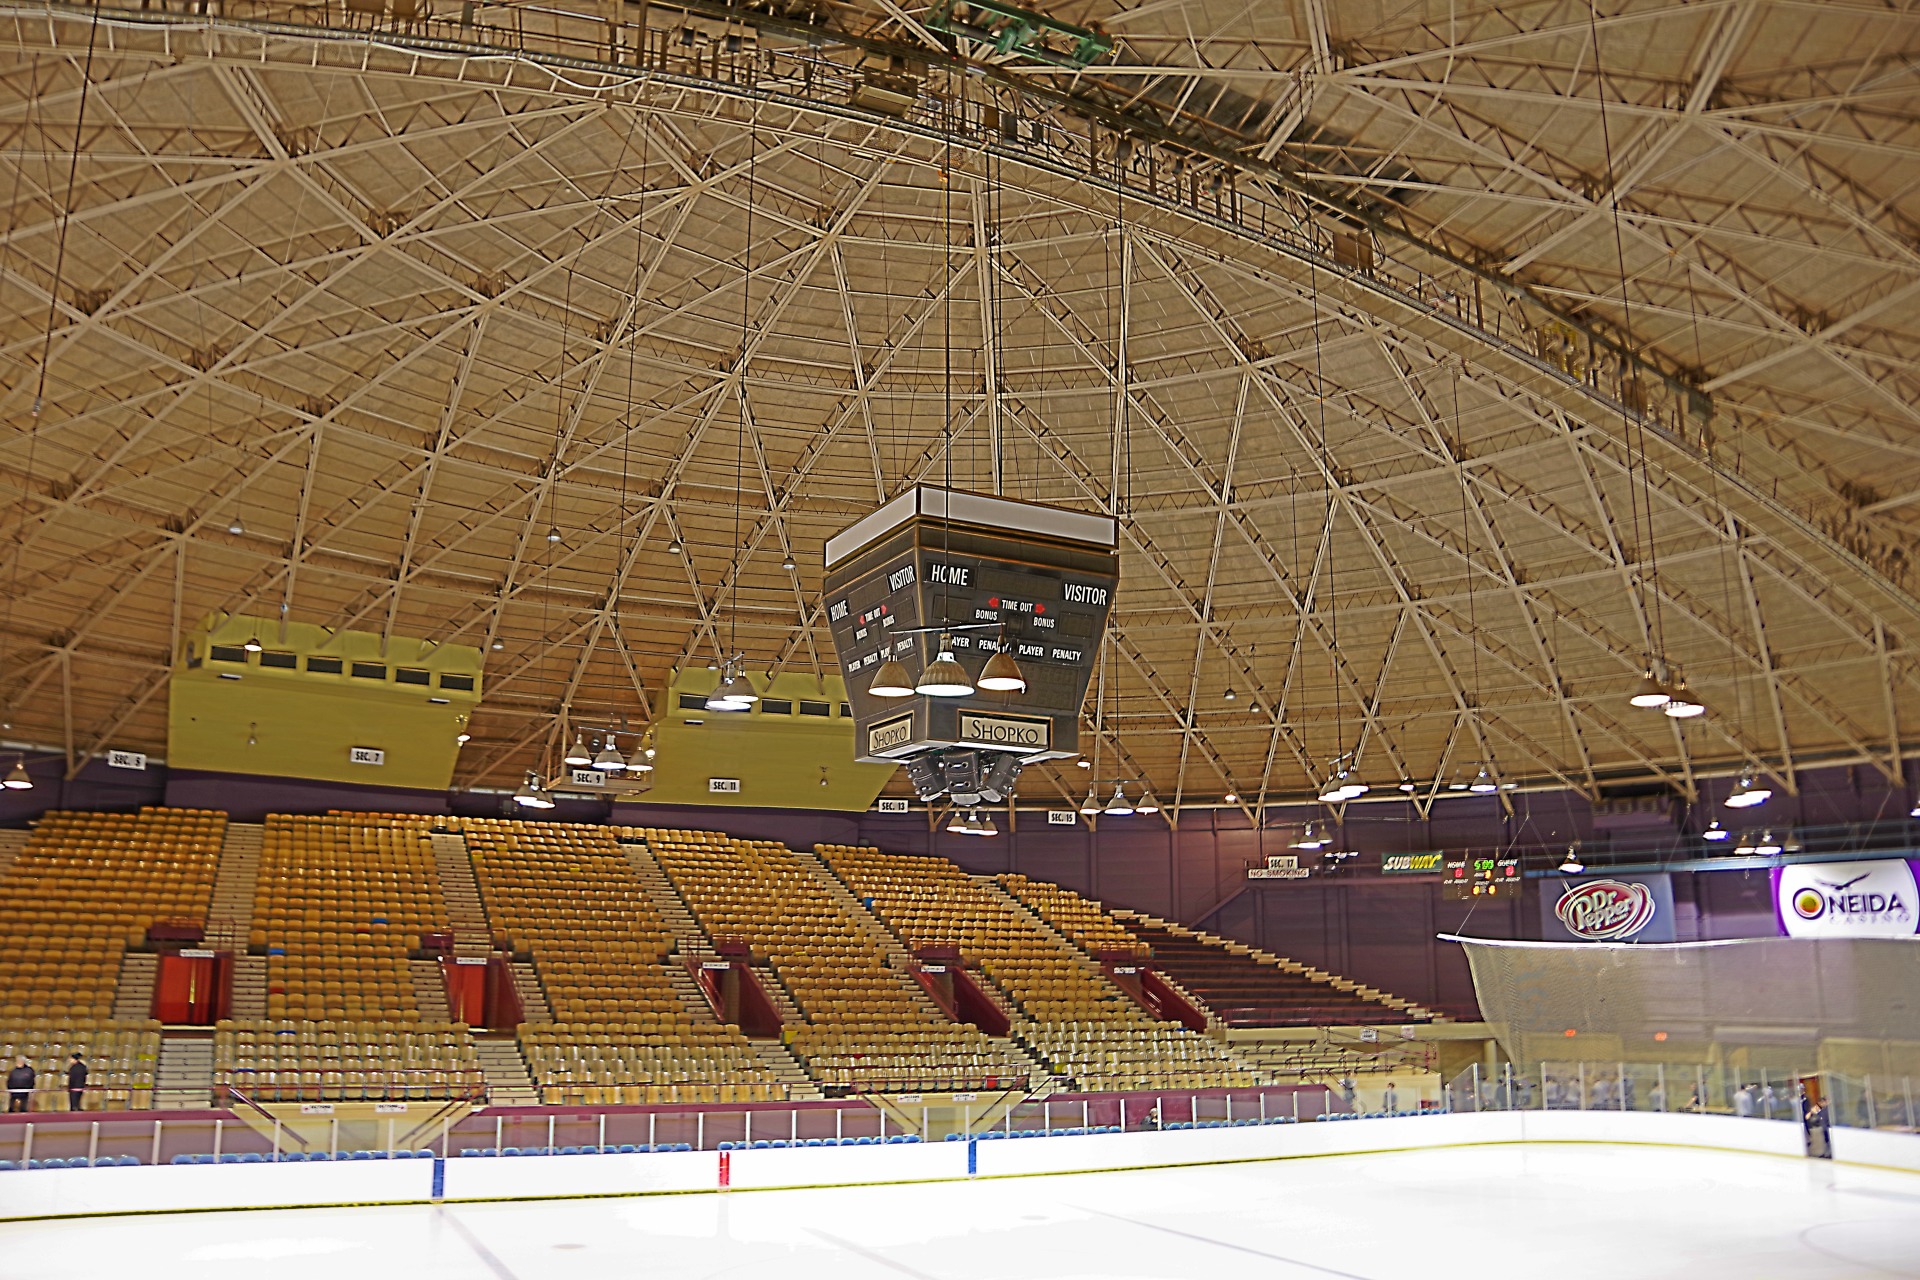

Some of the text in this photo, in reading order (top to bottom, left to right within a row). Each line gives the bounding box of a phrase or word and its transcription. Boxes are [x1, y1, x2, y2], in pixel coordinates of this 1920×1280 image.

[889, 565, 916, 591] VISITOR
[931, 564, 969, 586] HOME
[1065, 583, 1107, 606] VISITOR
[830, 600, 849, 621] HOME
[1002, 599, 1034, 612] TIME OUT
[975, 609, 998, 620] BONUS
[1033, 616, 1055, 628] BONUS
[1019, 644, 1081, 661] PLAYER PENALTY
[873, 726, 907, 749] SHOPKO
[971, 719, 1039, 744] SHOPKO
[577, 773, 601, 783] SEC. 9
[713, 781, 736, 790] SEC. 11
[882, 802, 905, 811] SEC. 13
[1051, 813, 1073, 822] SEC. 15
[1270, 859, 1295, 868] SEC. 17
[1383, 854, 1442, 870] SUBWAY
[1267, 869, 1307, 877] SMOKING
[1792, 887, 1906, 920] ONEIDA
[1568, 896, 1633, 931] Pepper
